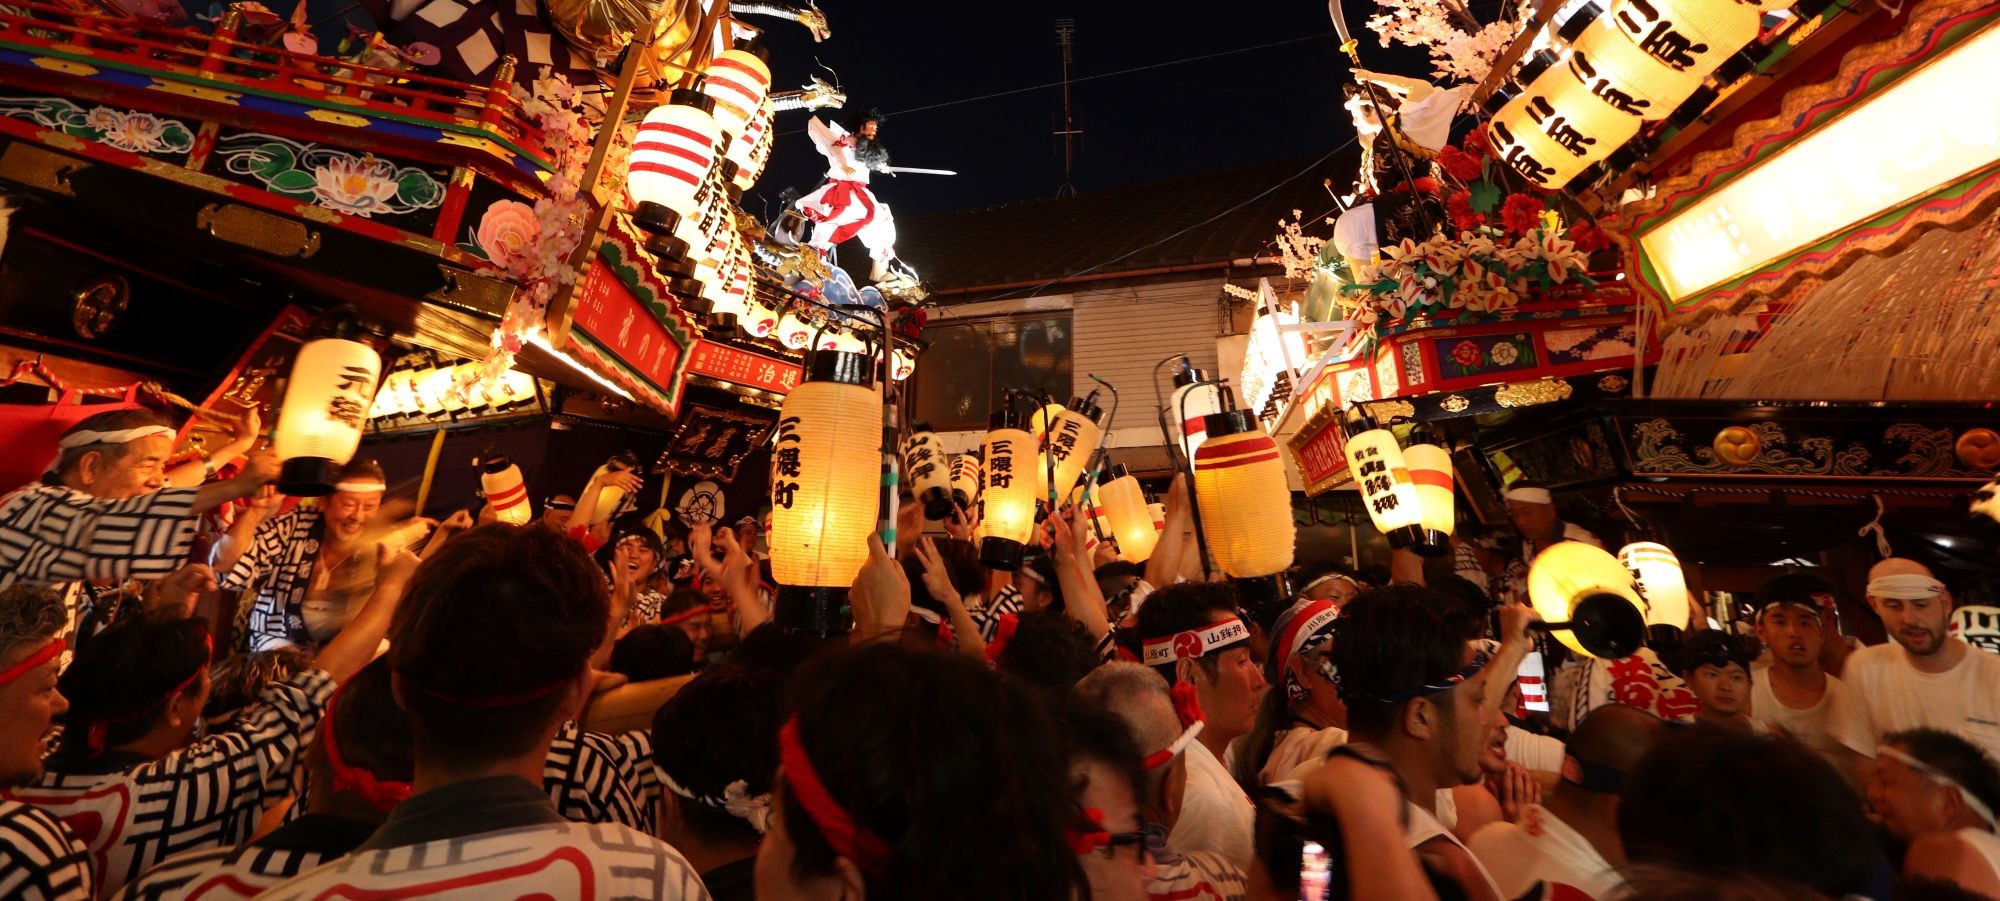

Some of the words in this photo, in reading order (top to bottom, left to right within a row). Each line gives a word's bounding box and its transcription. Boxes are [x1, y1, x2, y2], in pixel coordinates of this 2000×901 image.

[1050, 419, 1081, 462] 三隈町
[775, 416, 801, 509] 三隈町
[990, 440, 1013, 488] 三隈町
[1207, 624, 1247, 645] 山鉾押
[1307, 610, 1335, 630] 川原町
